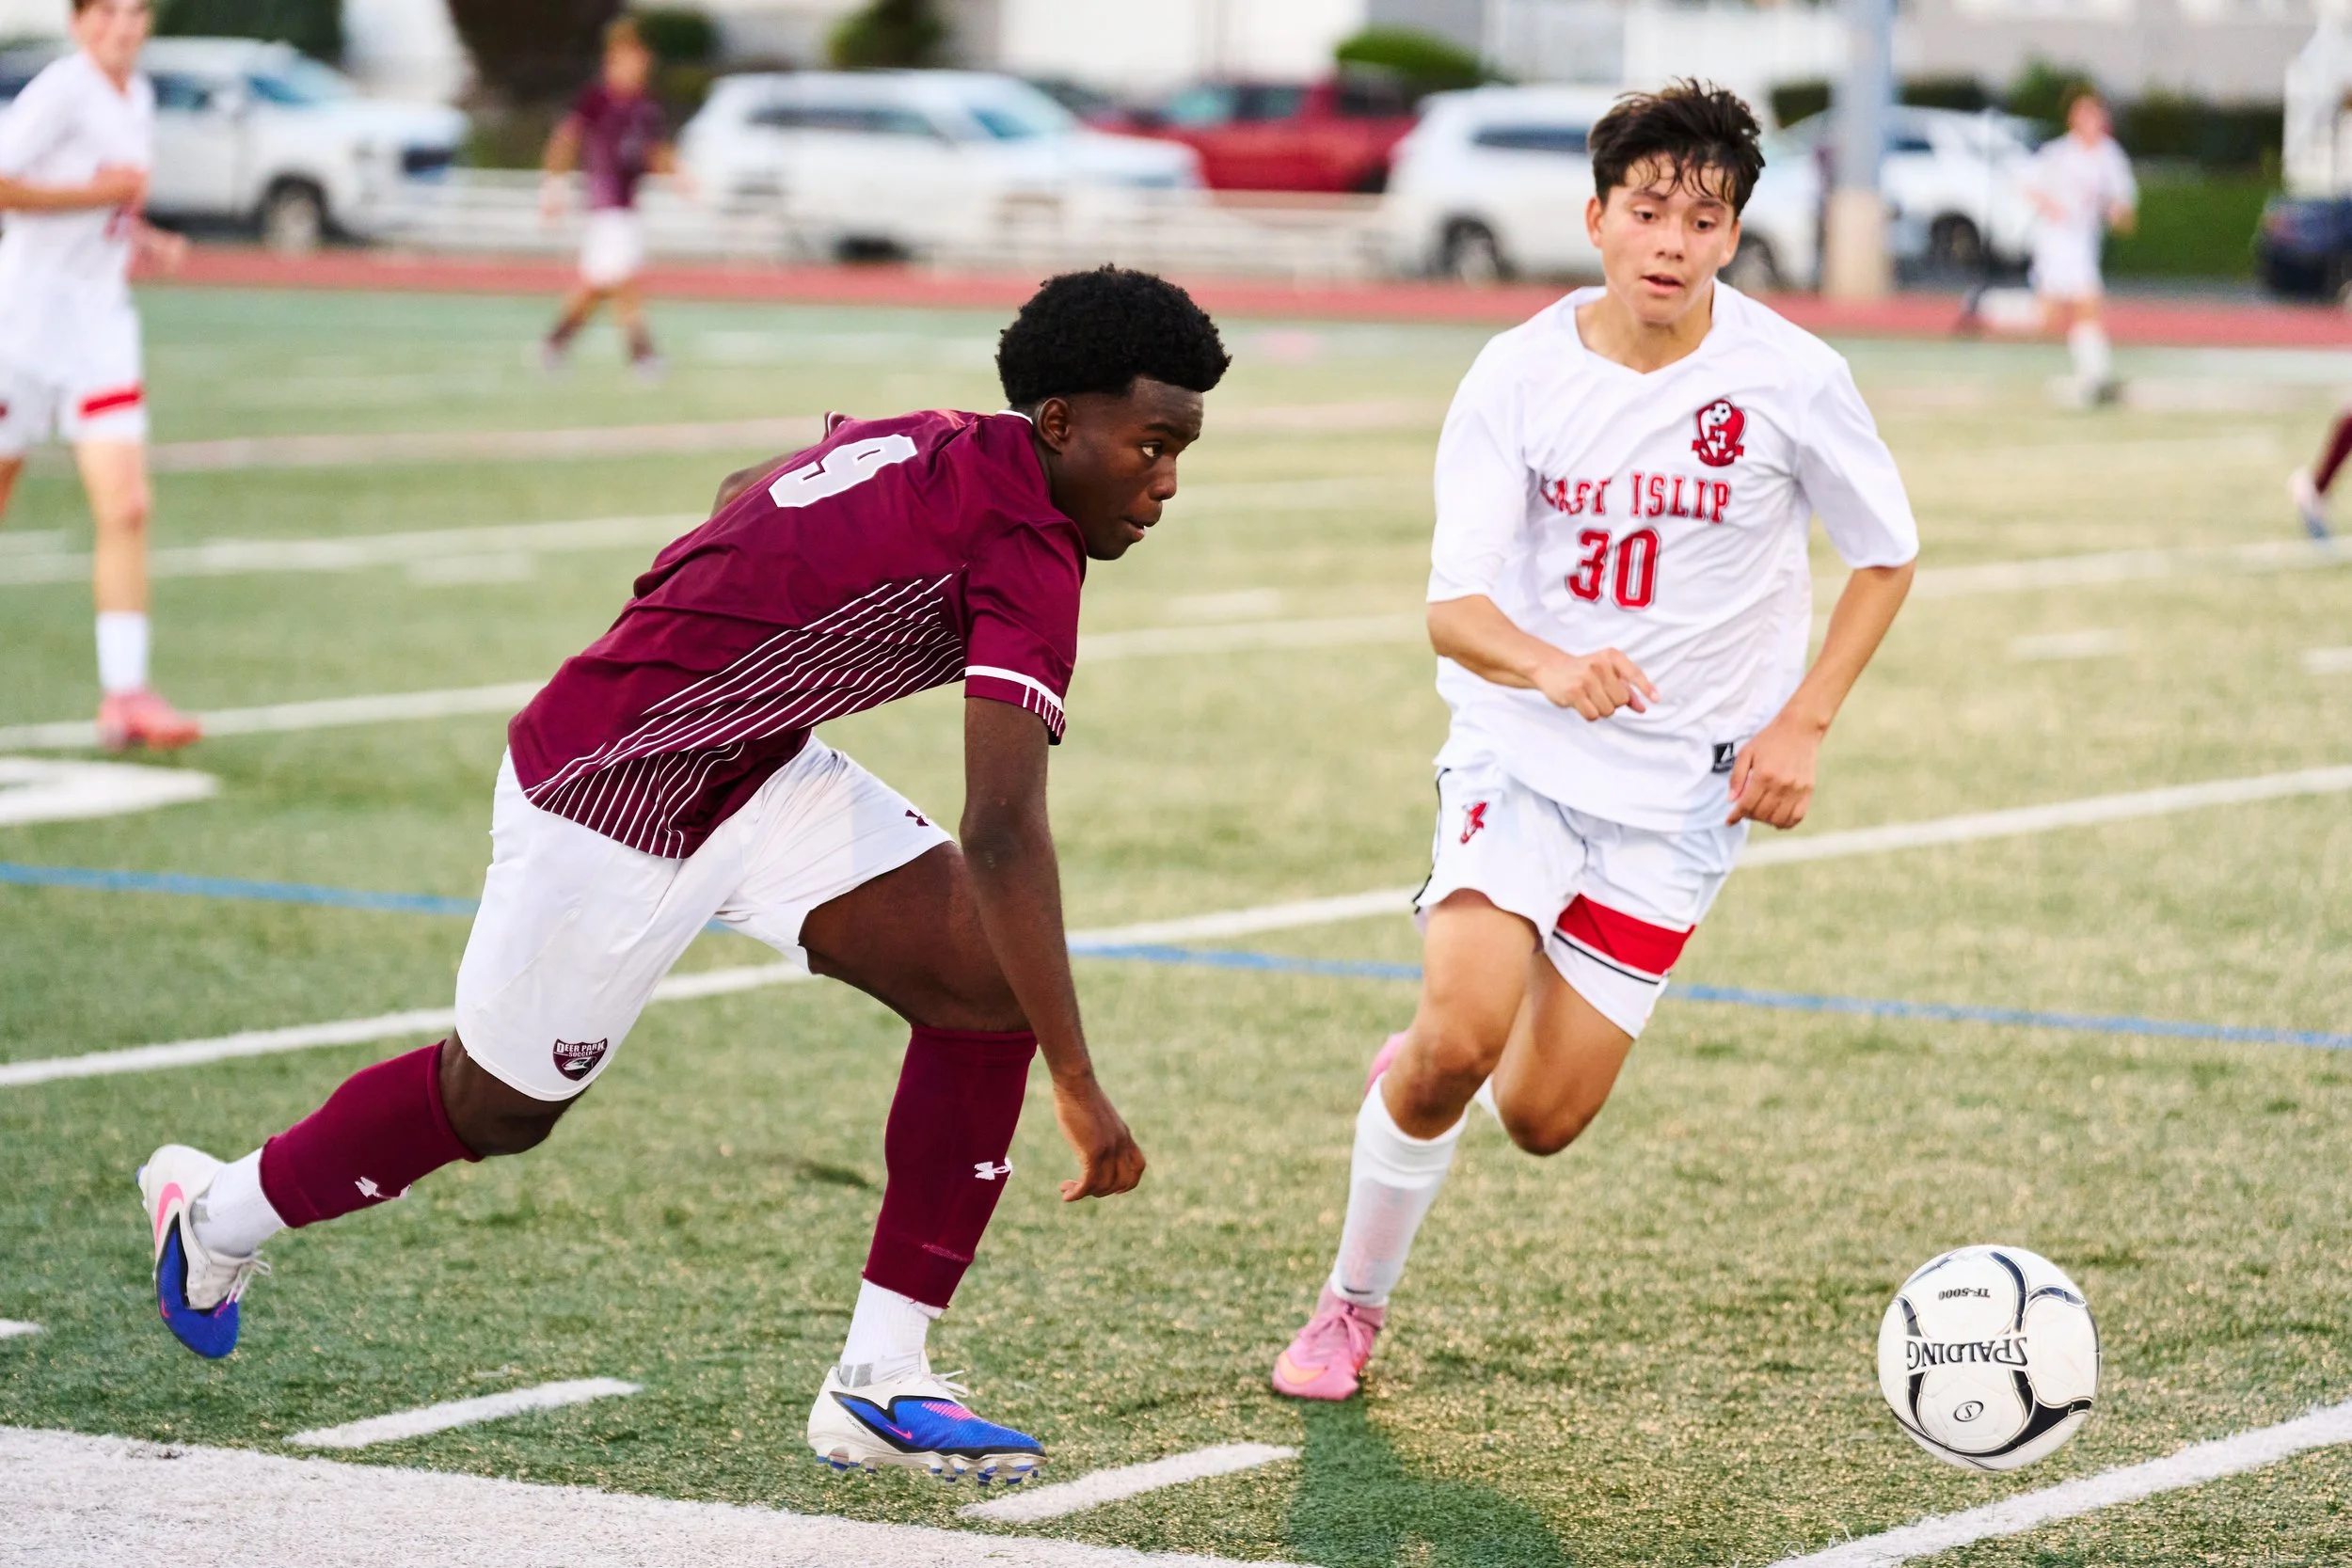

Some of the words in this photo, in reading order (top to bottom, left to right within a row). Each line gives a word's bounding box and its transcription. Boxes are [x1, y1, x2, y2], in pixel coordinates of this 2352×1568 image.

[769, 434, 918, 508] 9
[1630, 471, 1731, 524] ISLIP
[1565, 526, 1661, 611] 30
[556, 1042, 580, 1053] DEER
[581, 1041, 605, 1052] PARK
[1938, 1287, 1991, 1301] TF-5000
[1906, 1336, 2028, 1370] SPALDING
